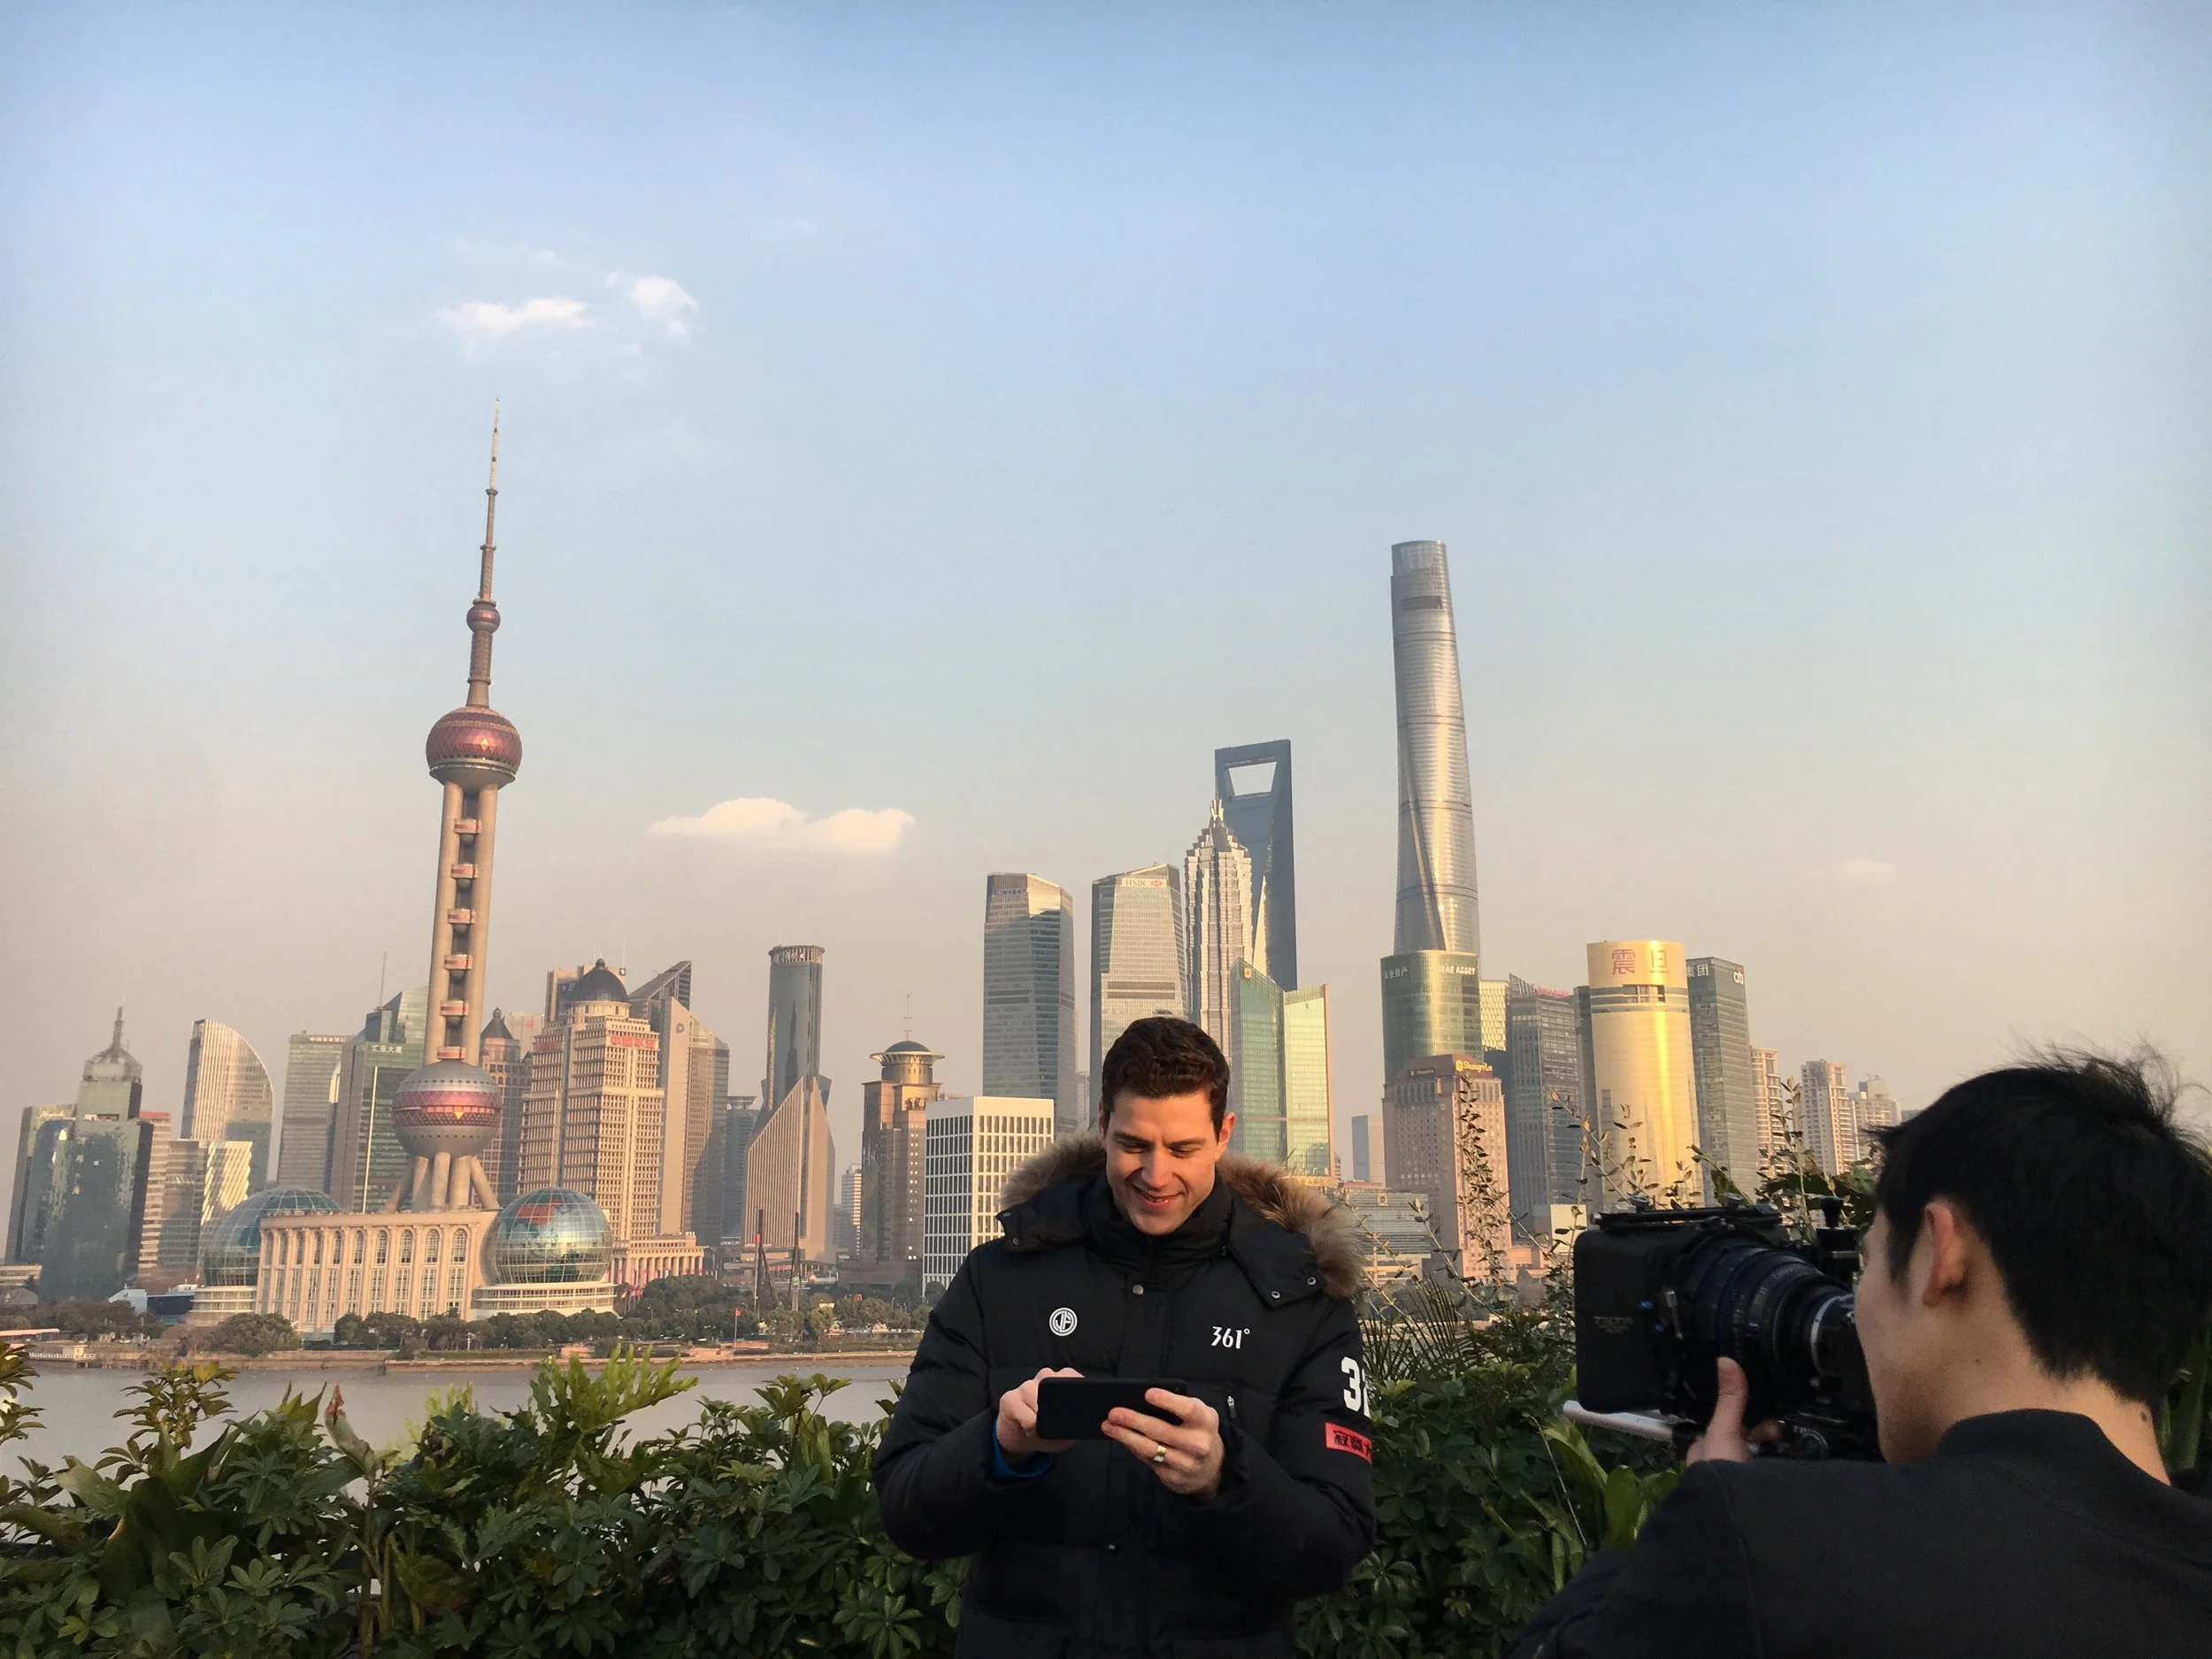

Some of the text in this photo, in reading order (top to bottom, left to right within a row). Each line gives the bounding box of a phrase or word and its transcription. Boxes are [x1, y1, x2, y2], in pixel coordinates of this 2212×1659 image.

[1455, 965, 1476, 975] ASSET
[1611, 949, 1671, 975] 震旦
[1211, 1326, 1250, 1349] 361°
